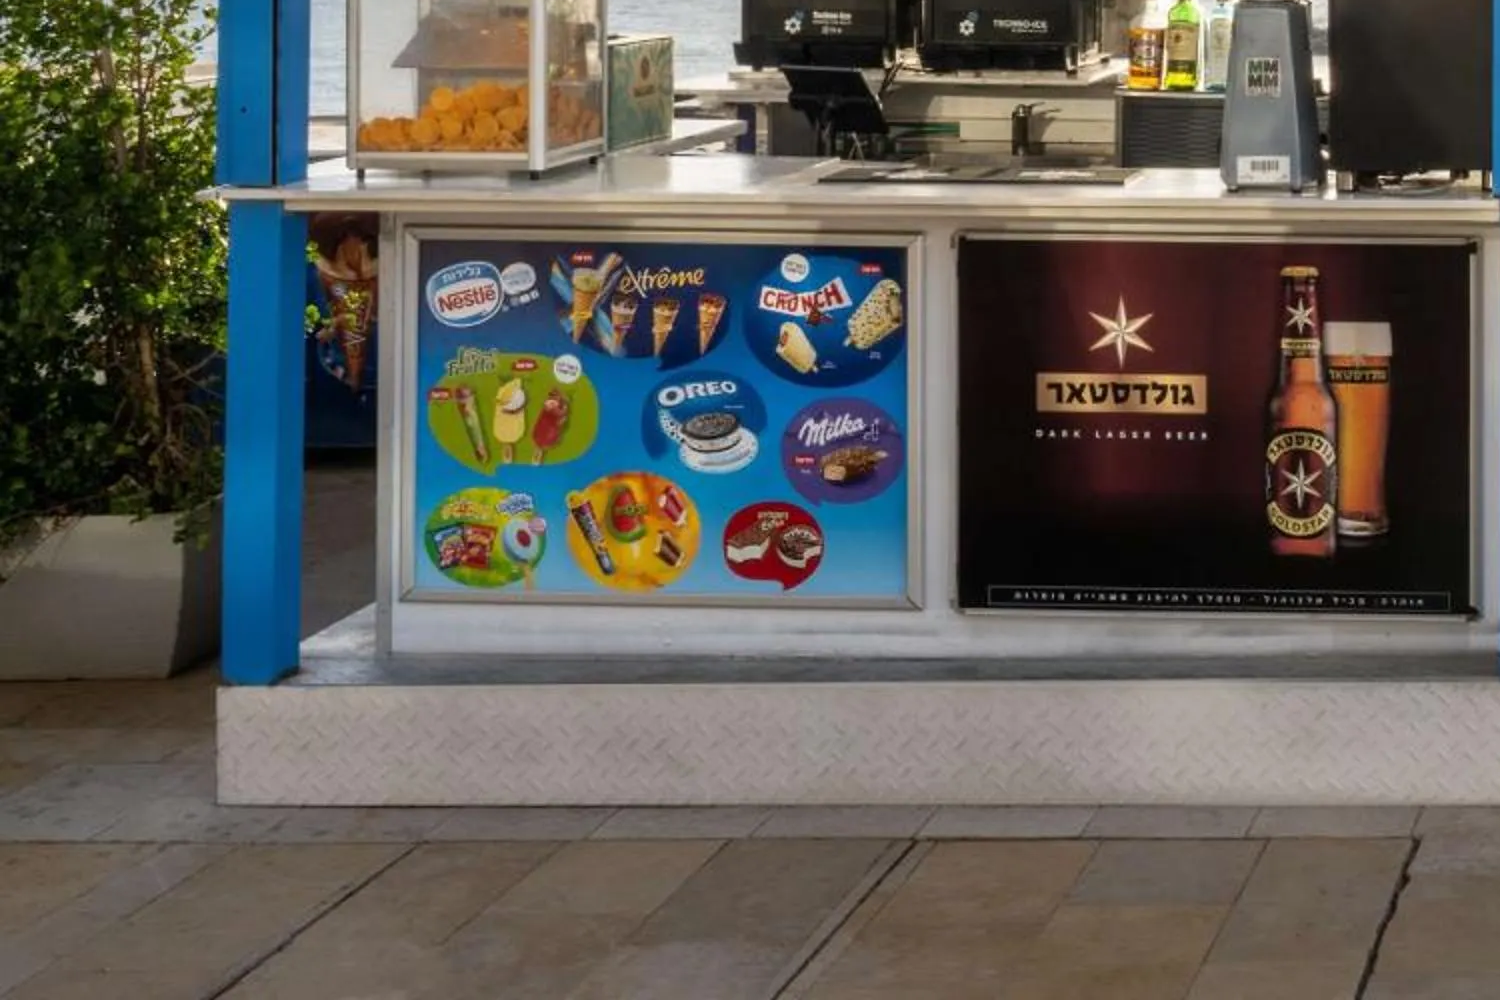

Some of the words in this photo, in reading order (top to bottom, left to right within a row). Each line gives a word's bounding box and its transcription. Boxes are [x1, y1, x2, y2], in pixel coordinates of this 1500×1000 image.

[763, 282, 845, 313] CRUNCH
[657, 380, 738, 406] OREO
[1046, 381, 1195, 406] גולדסטאר
[797, 413, 866, 447] Milka
[1035, 429, 1081, 438] DARK
[1271, 506, 1330, 534] GOLDSTAR
